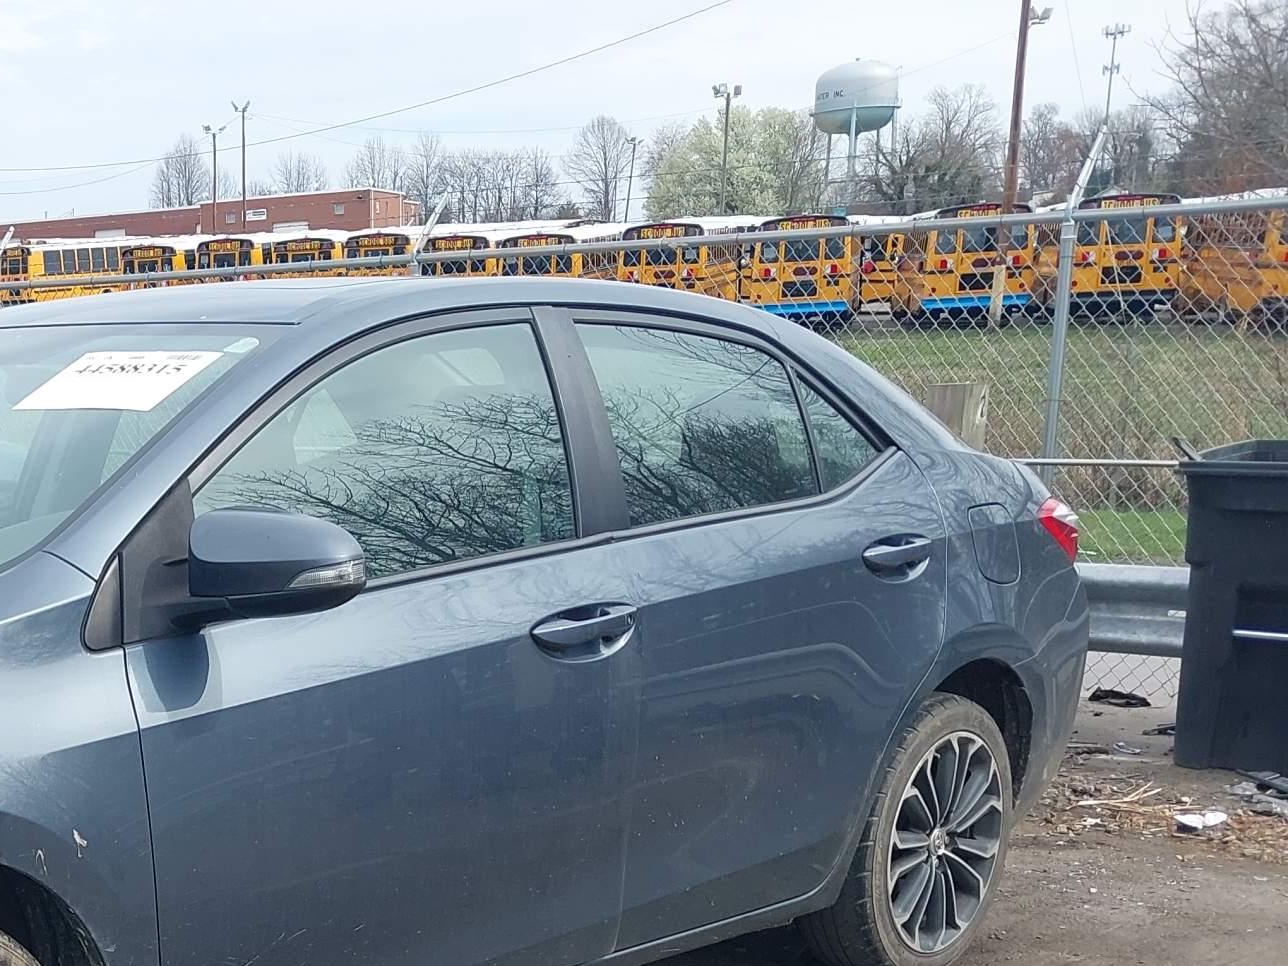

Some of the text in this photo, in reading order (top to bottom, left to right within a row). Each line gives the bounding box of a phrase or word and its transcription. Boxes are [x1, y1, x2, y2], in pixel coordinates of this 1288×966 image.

[780, 221, 812, 231] SCHOOL
[641, 228, 669, 239] SCHOOL
[518, 239, 544, 248] SCHOOL
